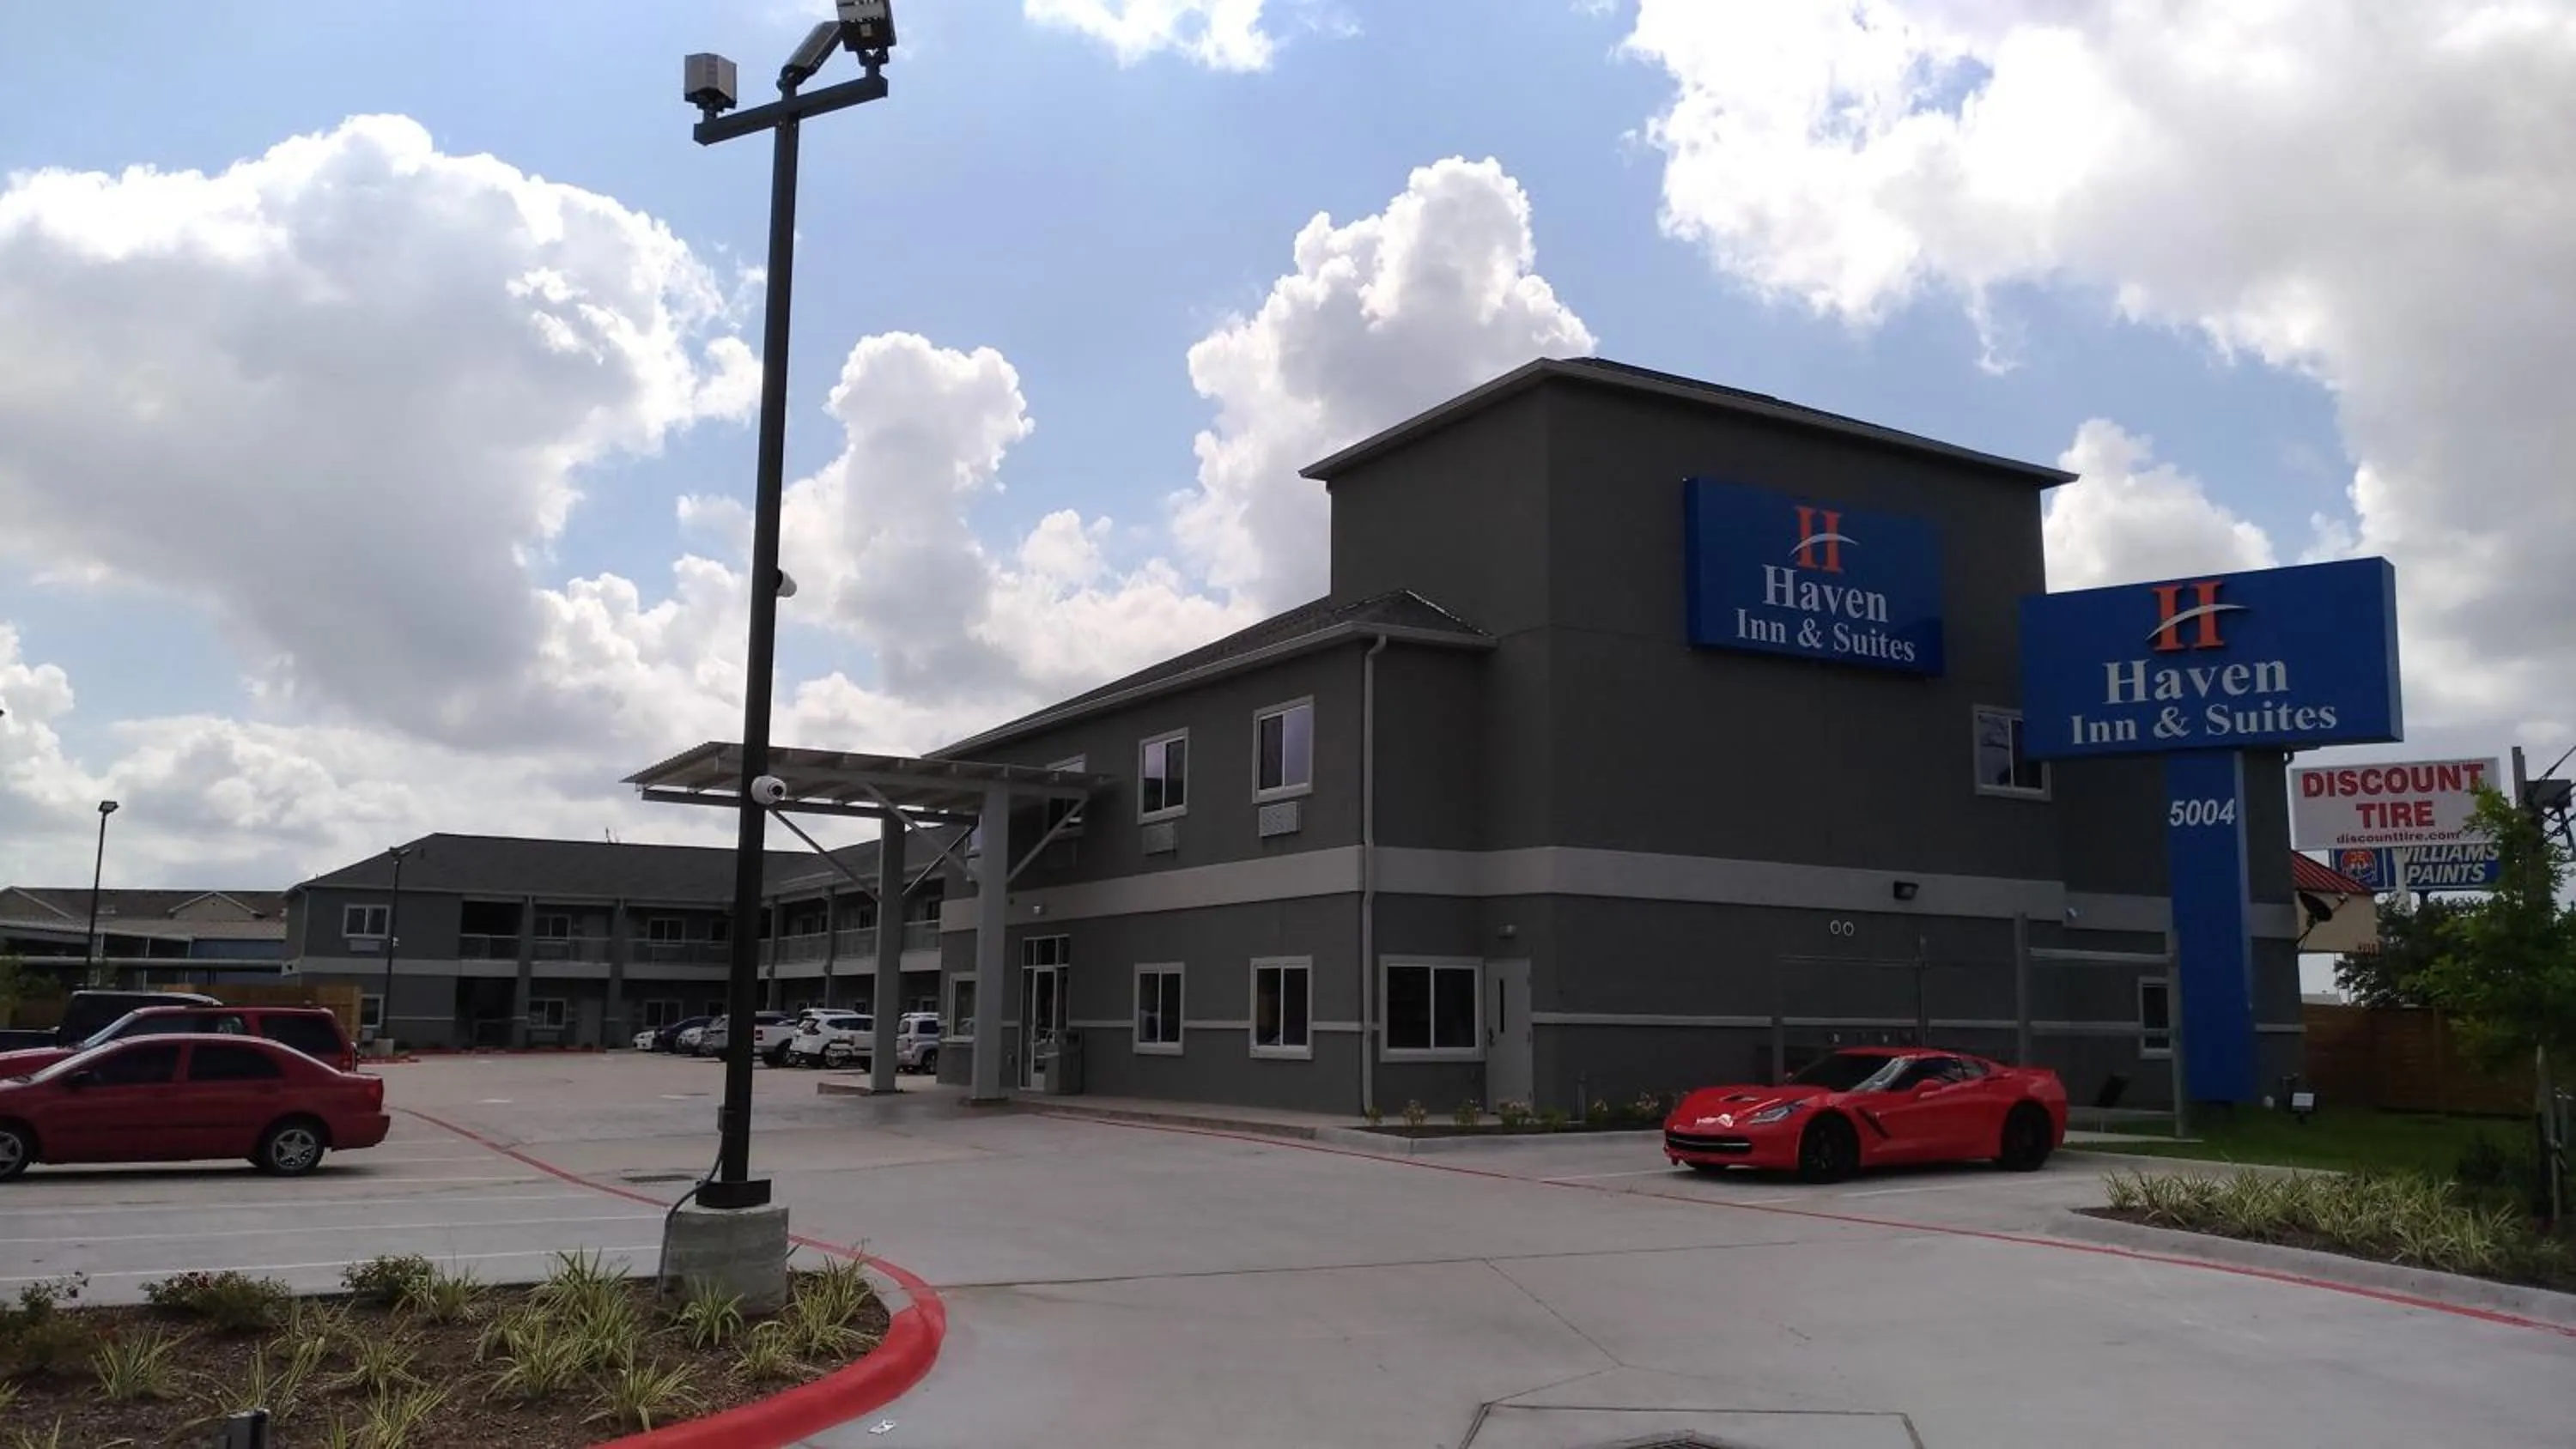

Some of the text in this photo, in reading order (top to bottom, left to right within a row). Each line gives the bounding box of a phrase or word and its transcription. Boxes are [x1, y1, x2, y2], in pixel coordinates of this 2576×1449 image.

[1795, 506, 1842, 572] H
[1762, 564, 1888, 621] Haven
[1735, 609, 1916, 662] Inn & Suites
[2152, 580, 2225, 651] H
[2103, 658, 2290, 705] Haven
[2070, 701, 2337, 745] Inn & Suites
[2301, 762, 2485, 797] DISCOUNT
[2169, 798, 2236, 828] 5004
[2355, 800, 2435, 828] TIRE
[2405, 863, 2486, 884] PAINTS
